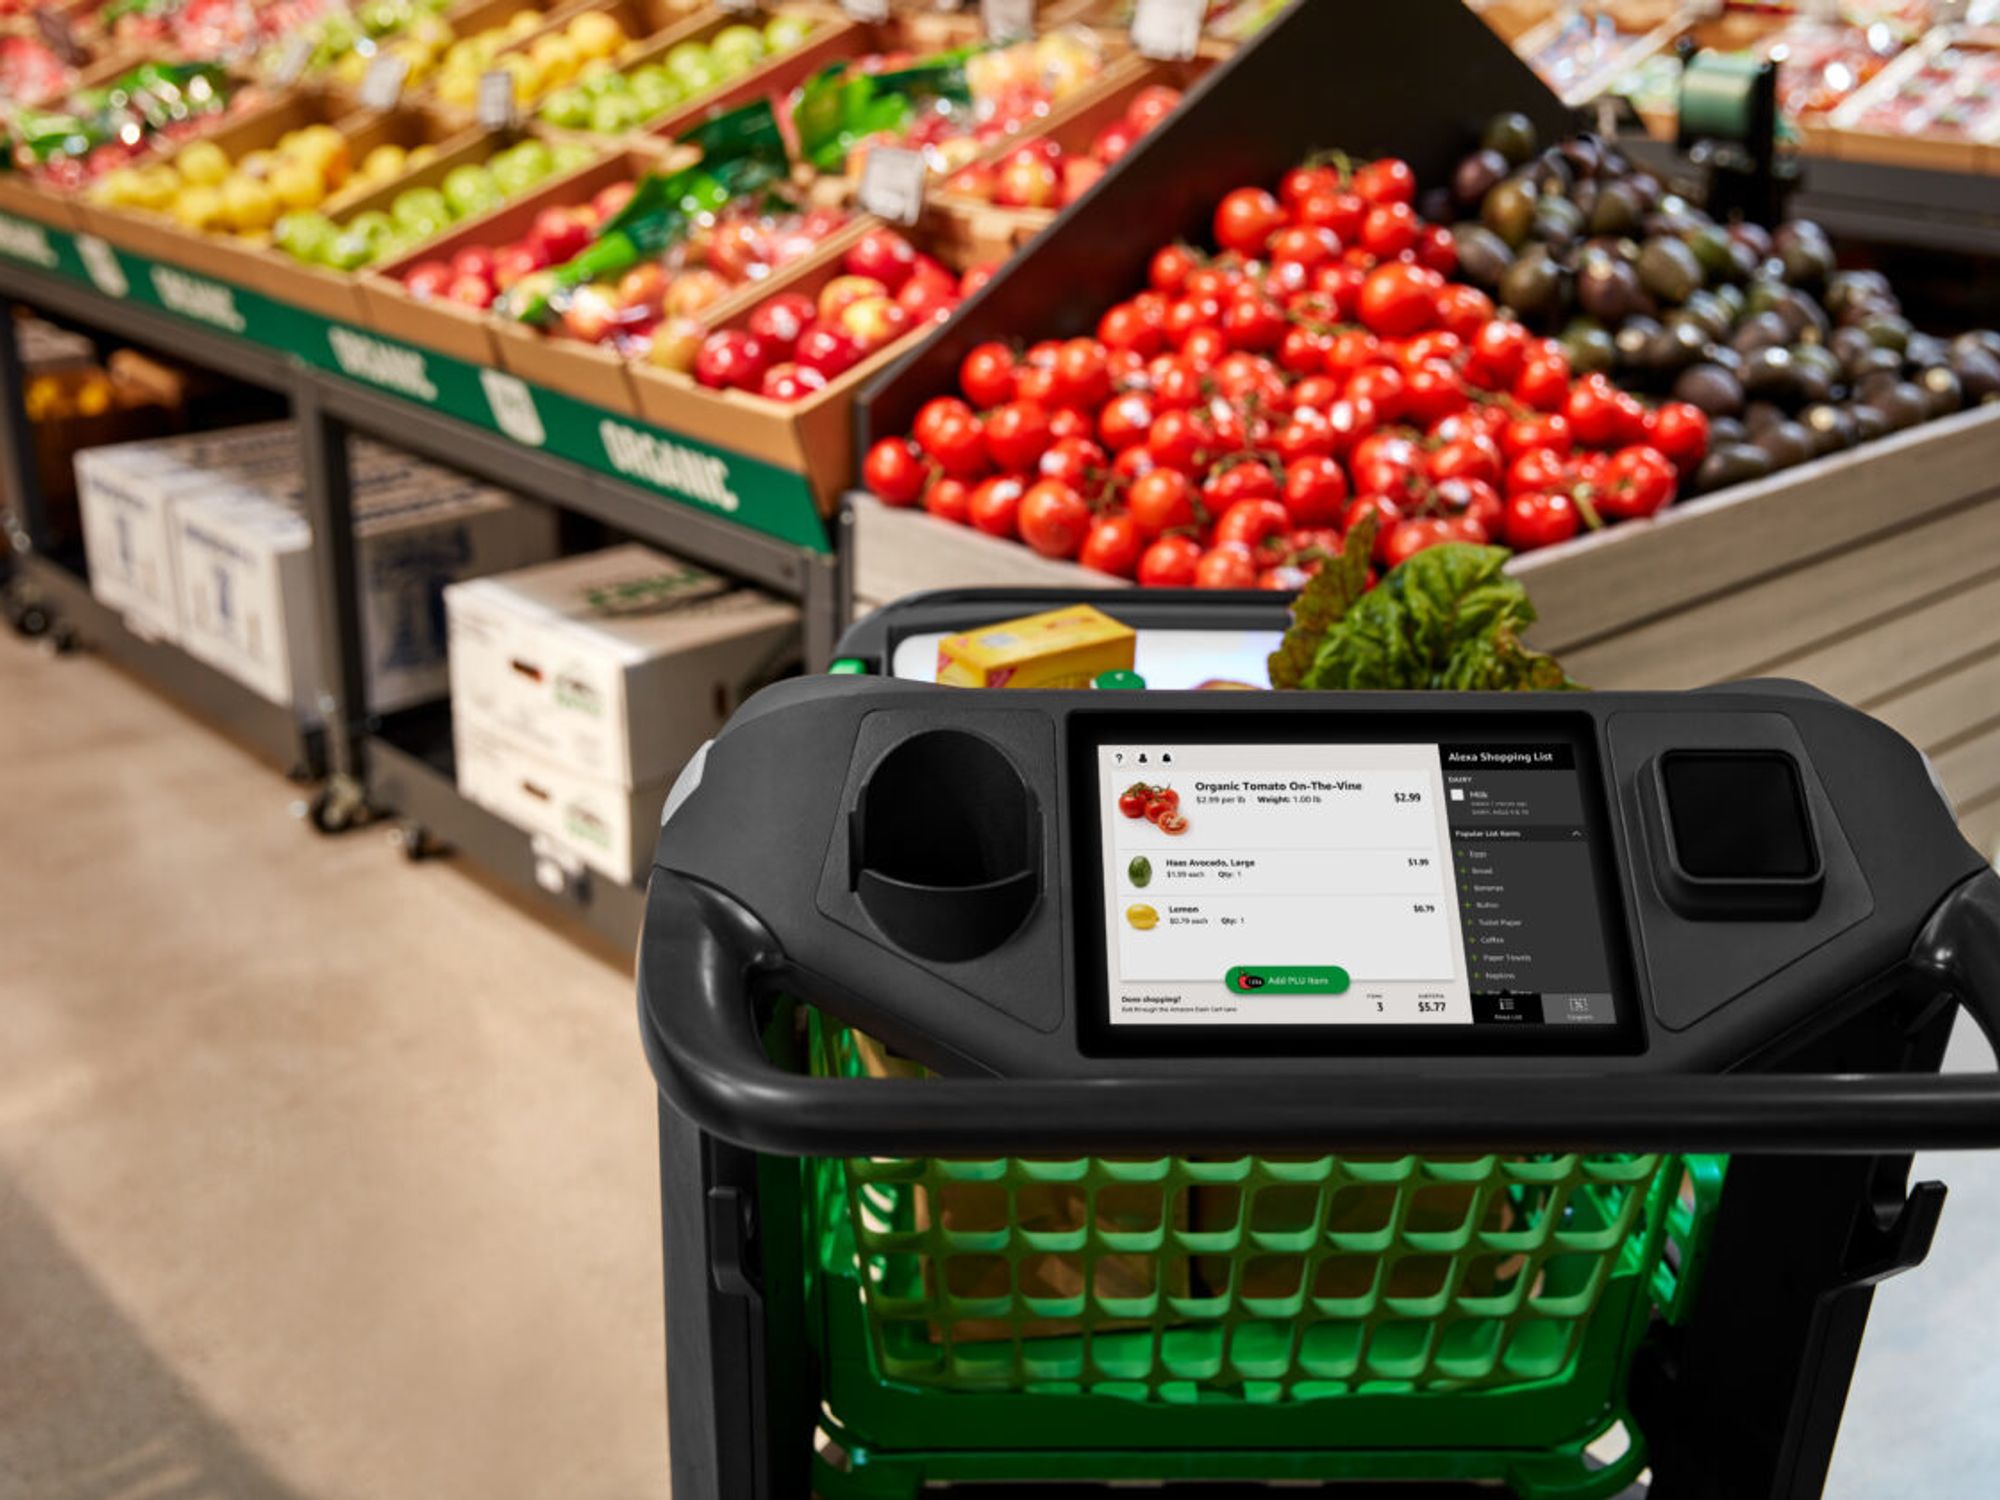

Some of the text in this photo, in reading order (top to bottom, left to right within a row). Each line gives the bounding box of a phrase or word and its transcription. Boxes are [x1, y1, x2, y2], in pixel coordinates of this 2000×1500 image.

[600, 419, 739, 511] ORGANIC
[1448, 752, 1553, 764] Alexa Shopping List
[1195, 781, 1363, 794] Organic Tomato On-The-Vine
[1196, 796, 1220, 804] $2.99
[1221, 797, 1235, 805] per
[1257, 796, 1290, 805] Weight:
[1394, 792, 1421, 803] $2.99
[1189, 859, 1229, 868] Avocado,
[1230, 859, 1255, 869] Large
[1408, 858, 1429, 867] $1.99
[1168, 905, 1199, 913] Lemon
[1413, 904, 1435, 913] $0.79
[1268, 976, 1287, 985] Add
[1307, 976, 1329, 985] Item
[1376, 1001, 1384, 1012] 3
[1418, 1001, 1446, 1012] $5.77
